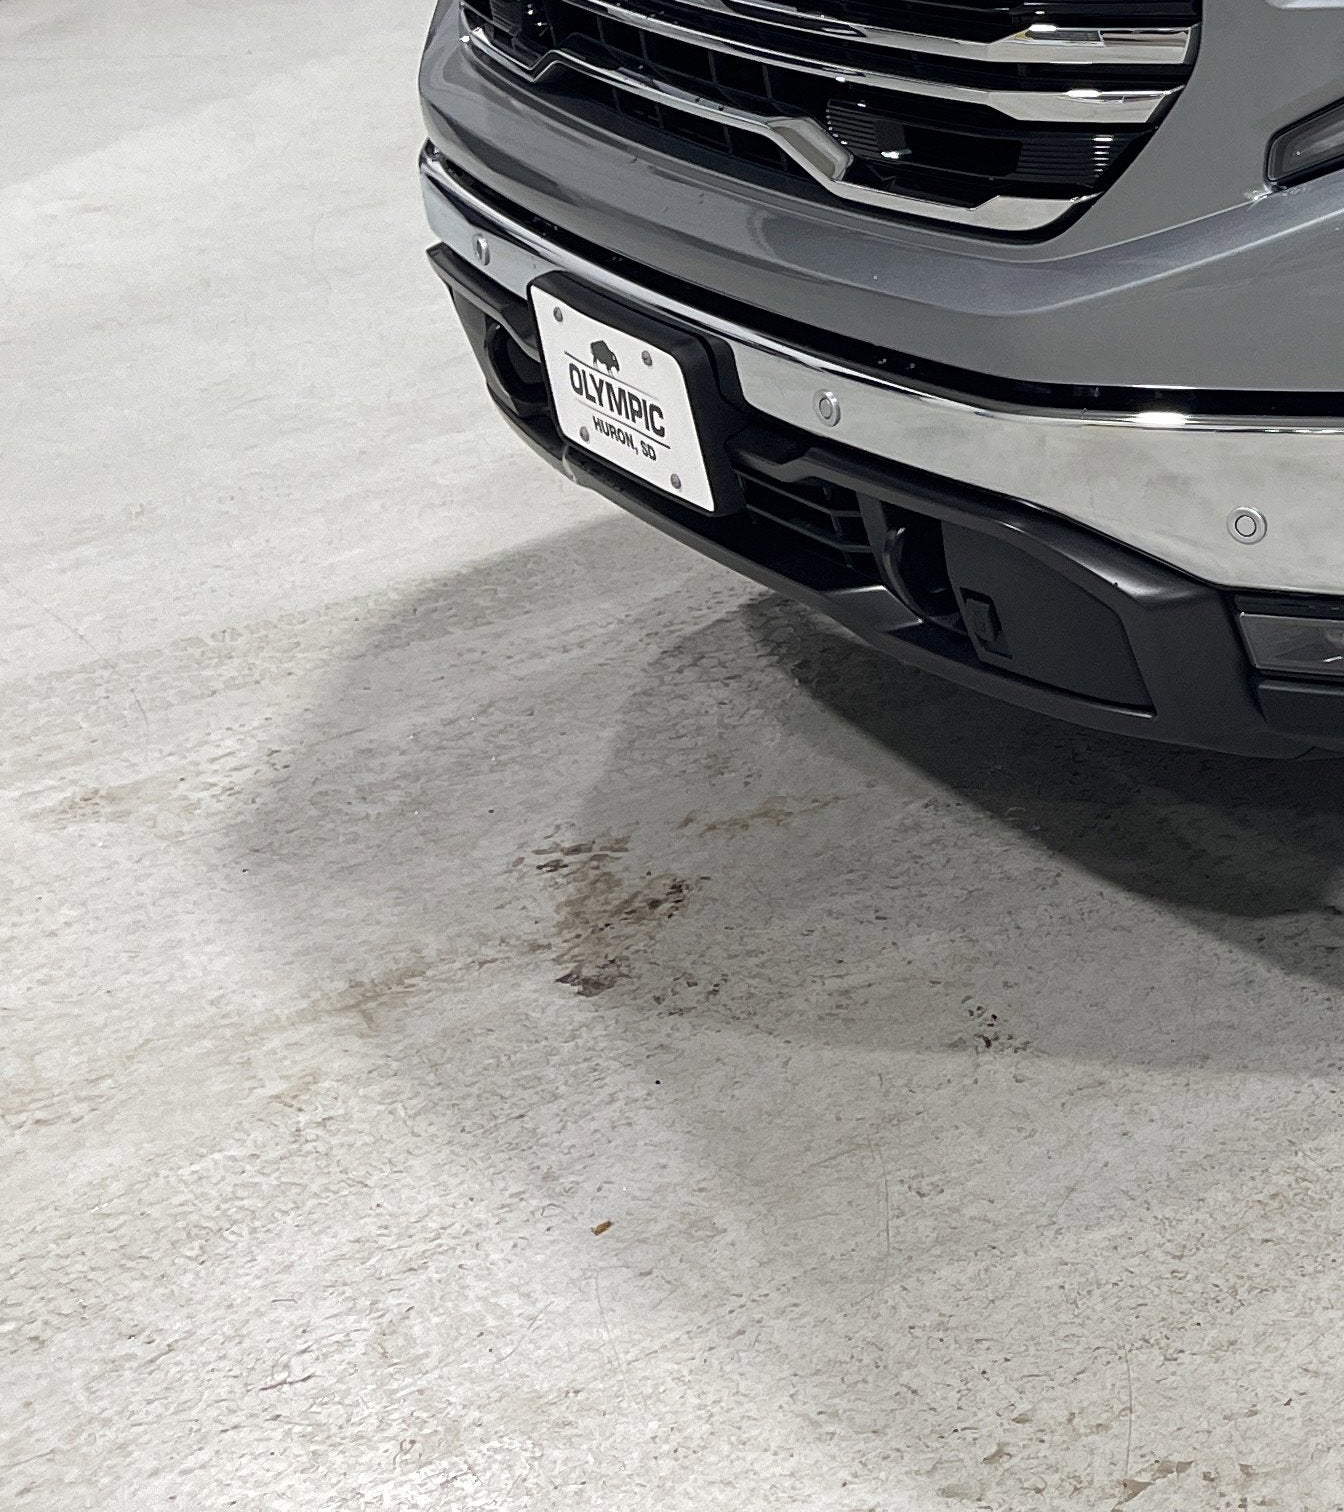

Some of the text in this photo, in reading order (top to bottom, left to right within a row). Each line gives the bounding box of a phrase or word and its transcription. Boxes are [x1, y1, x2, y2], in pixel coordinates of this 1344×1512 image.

[568, 363, 666, 438] OLYMPIC
[592, 416, 657, 461] HURON, SD
